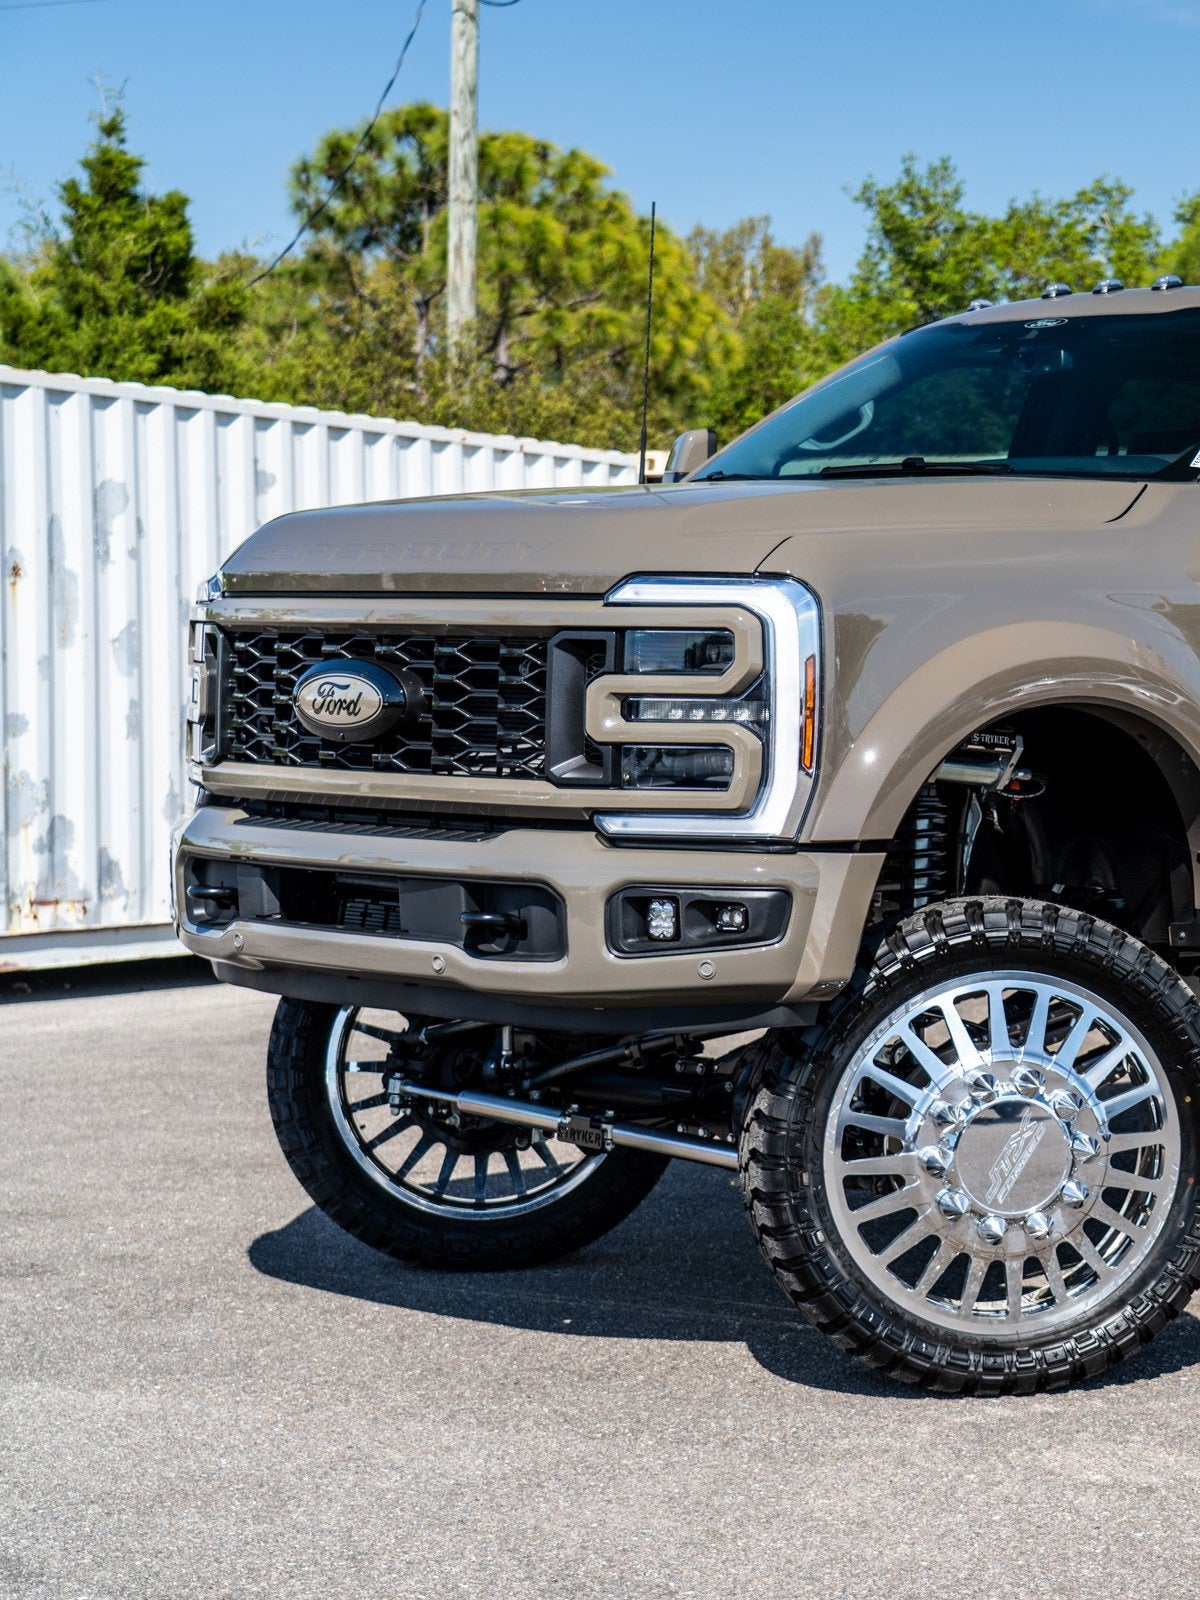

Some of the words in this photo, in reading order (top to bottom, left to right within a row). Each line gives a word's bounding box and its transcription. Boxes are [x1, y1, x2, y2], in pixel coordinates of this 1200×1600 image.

[251, 541, 393, 561] SUPER
[398, 541, 553, 561] DUTY
[312, 681, 364, 717] Ford
[973, 733, 1011, 746] STRYKER
[839, 993, 926, 1089] FORGED
[558, 1126, 601, 1146] STRYKER
